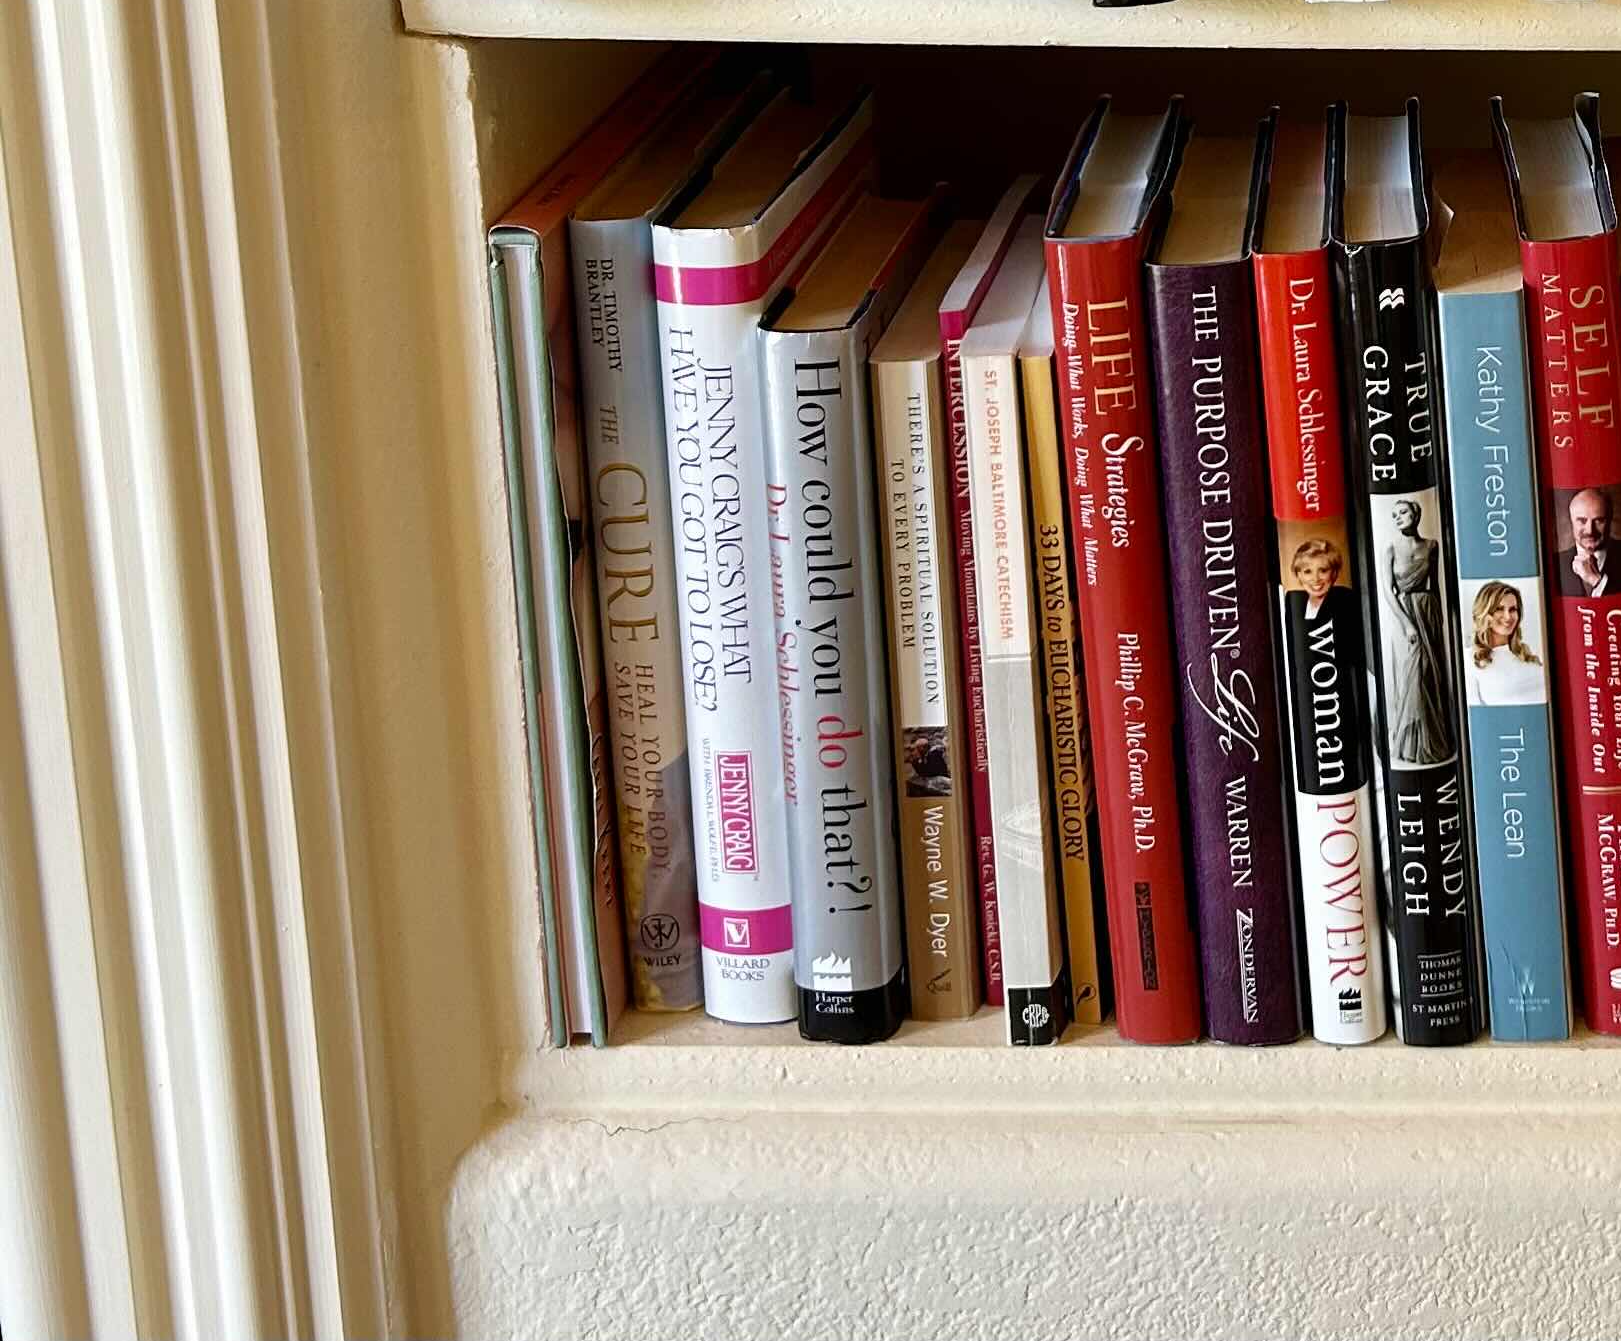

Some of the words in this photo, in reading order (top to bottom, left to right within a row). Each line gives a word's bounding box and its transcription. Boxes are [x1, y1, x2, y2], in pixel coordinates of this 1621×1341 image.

[1192, 286, 1219, 341] THE
[1290, 277, 1316, 316] Dr.
[669, 326, 697, 412] HAVE
[1086, 299, 1137, 416] LIFE
[1293, 323, 1317, 383] Laura
[1472, 346, 1505, 434] Kathy
[1542, 273, 1573, 449] MATTERS
[1569, 285, 1614, 429] SELF
[600, 405, 618, 445] THE
[698, 359, 737, 470] JENNY
[794, 358, 841, 466] How
[1192, 354, 1231, 506] PURPOSE
[1296, 389, 1327, 512] Schlessinger
[1363, 345, 1397, 482] GRACE
[1404, 353, 1433, 463] TRUE
[676, 420, 702, 487] YOU
[1101, 433, 1144, 548] Strategies
[681, 492, 707, 564] GOT
[710, 472, 746, 588] CRAIG'S
[799, 480, 855, 605] could
[1039, 525, 1058, 548] 33
[1483, 445, 1510, 557] Freston
[600, 461, 660, 643] CURE
[686, 571, 710, 613] TO
[1041, 555, 1065, 610] DAYS
[688, 622, 718, 712] LOSE?
[718, 590, 752, 683] WHAT
[795, 618, 841, 698] you
[1047, 614, 1063, 632] to
[817, 715, 864, 768] do
[1048, 639, 1079, 785] EUCHARISTIC
[1307, 624, 1344, 787] woman
[1500, 727, 1524, 783] The
[821, 785, 874, 914] that?!
[923, 805, 943, 873] Wayne
[1060, 794, 1085, 861] GLORY
[1224, 775, 1252, 888] WARREN
[1397, 794, 1429, 916] LEIGH
[1436, 775, 1467, 917] WENDY
[1503, 792, 1527, 859] Lean
[927, 879, 948, 906] W.
[930, 913, 951, 958] Dyer
[1317, 799, 1368, 984] POWER
[643, 954, 681, 967] WILEY
[716, 959, 769, 968] VILLARD
[721, 971, 765, 981] BOOKS
[1236, 908, 1259, 1024] ZONDERVAN
